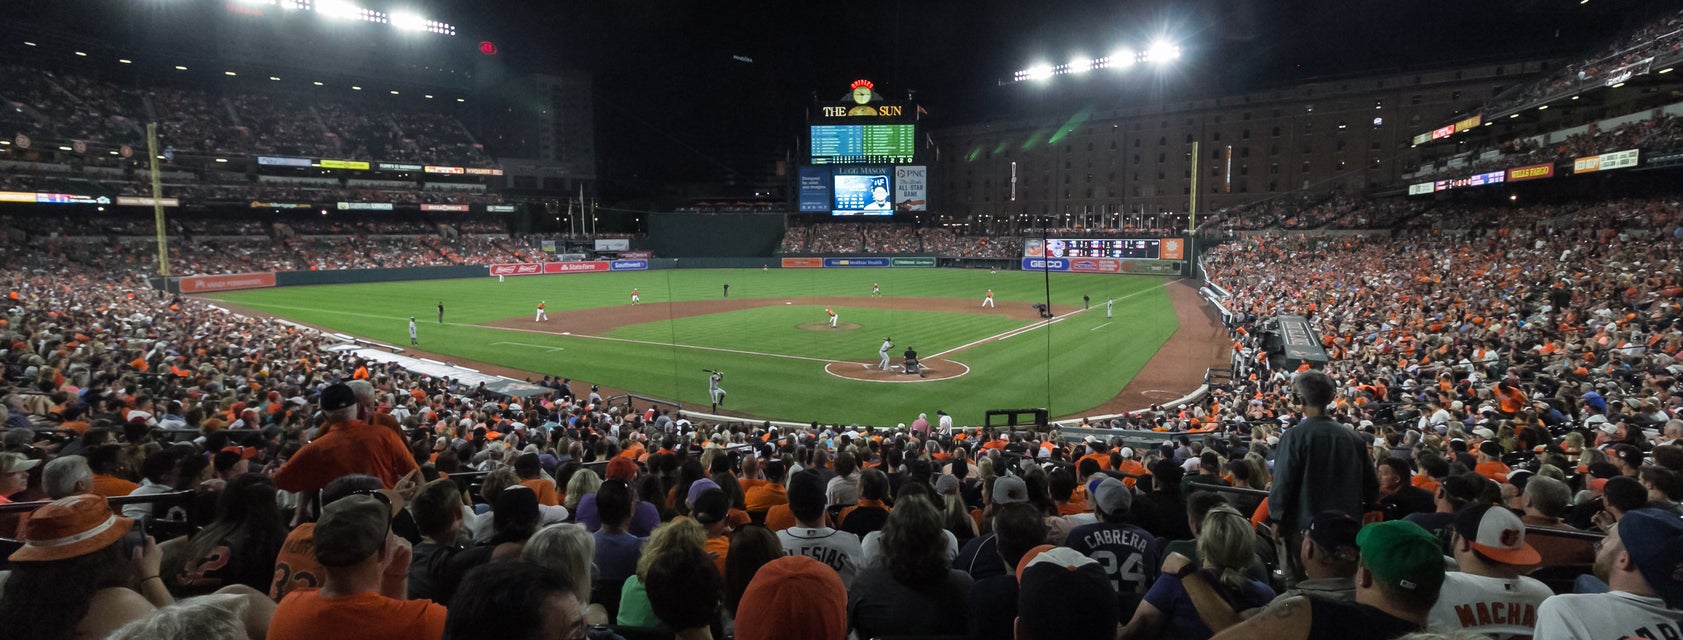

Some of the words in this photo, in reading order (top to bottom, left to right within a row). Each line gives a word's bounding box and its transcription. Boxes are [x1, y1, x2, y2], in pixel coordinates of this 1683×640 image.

[823, 106, 846, 117] THE
[879, 106, 902, 116] SUN
[906, 169, 925, 177] PNC
[1030, 260, 1063, 269] GECO
[1084, 528, 1148, 553] CABRERA
[1089, 550, 1146, 594] 24
